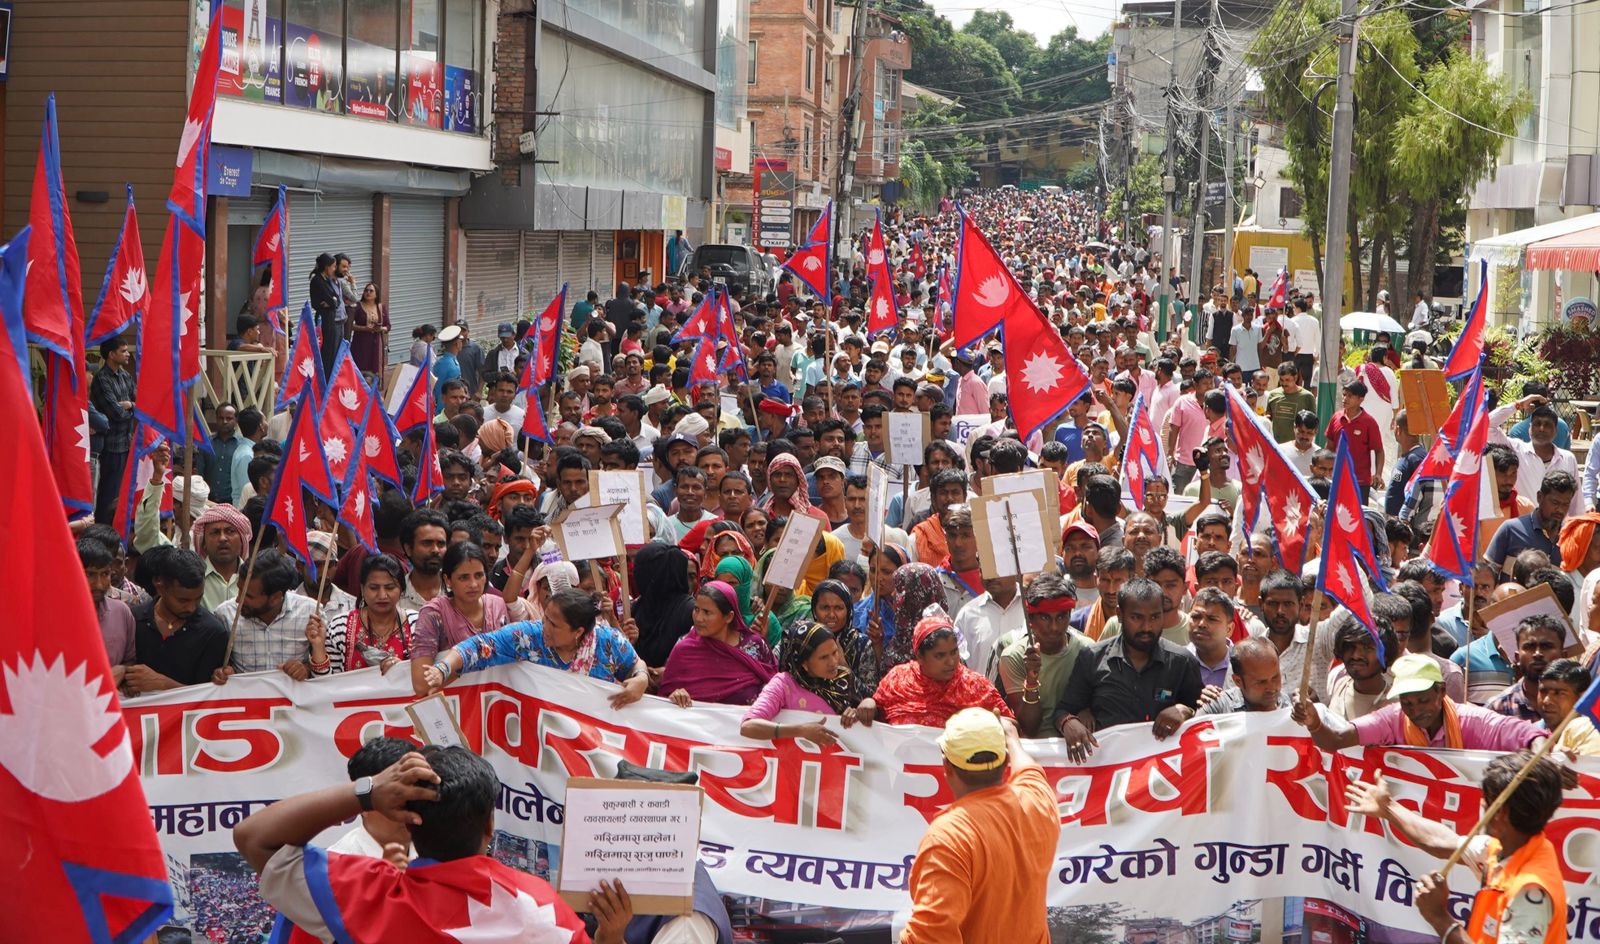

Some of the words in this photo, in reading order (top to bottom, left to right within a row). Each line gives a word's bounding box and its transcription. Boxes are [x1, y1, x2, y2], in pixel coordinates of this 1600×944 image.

[294, 77, 308, 87] FRENCH
[310, 74, 319, 86] SAT
[264, 86, 280, 98] FRANCE
[224, 165, 240, 177] Everest
[1058, 838, 1180, 884] गरेको
[1194, 841, 1290, 884] गुन्डा
[1301, 843, 1364, 894] गर्दी
